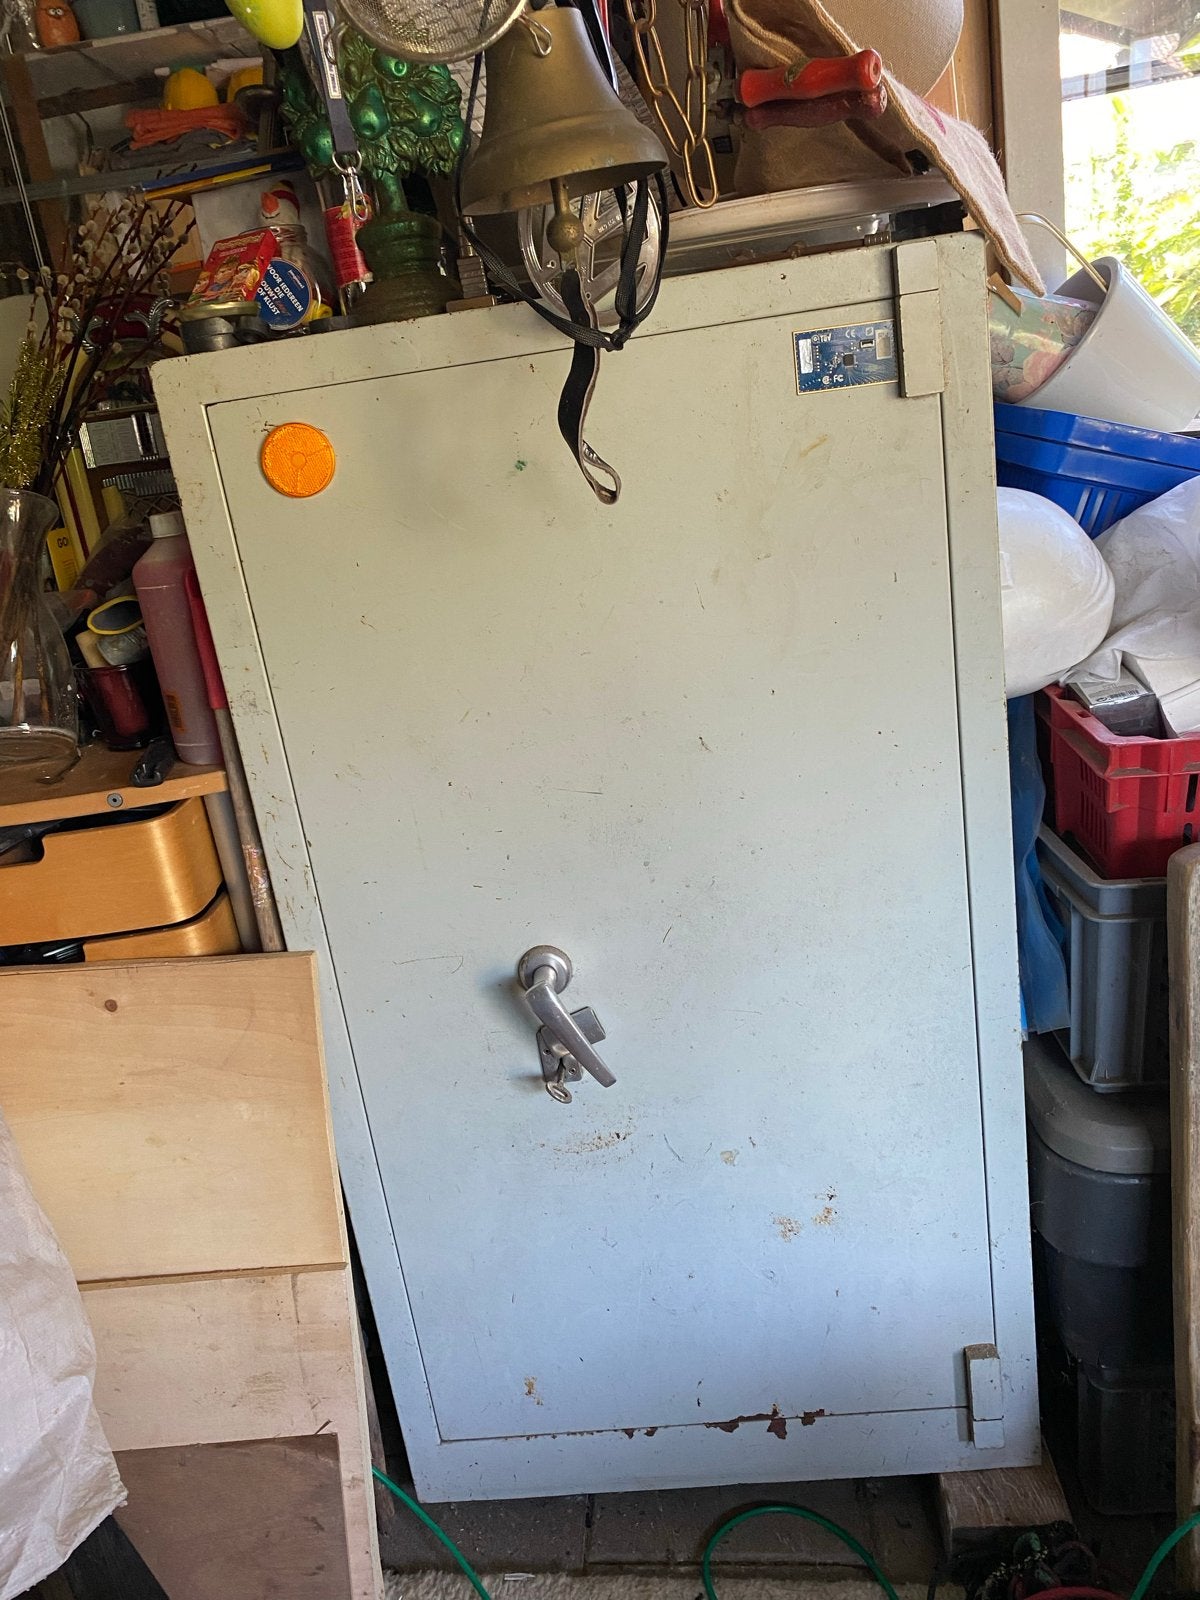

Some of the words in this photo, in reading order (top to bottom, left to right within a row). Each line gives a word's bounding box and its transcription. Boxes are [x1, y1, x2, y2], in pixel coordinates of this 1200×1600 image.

[260, 280, 278, 301] OUWT
[267, 263, 283, 284] VOOR
[279, 282, 304, 312] IEDEREEN
[274, 286, 285, 299] DIE
[257, 287, 267, 297] OF
[263, 295, 280, 315] KLUST
